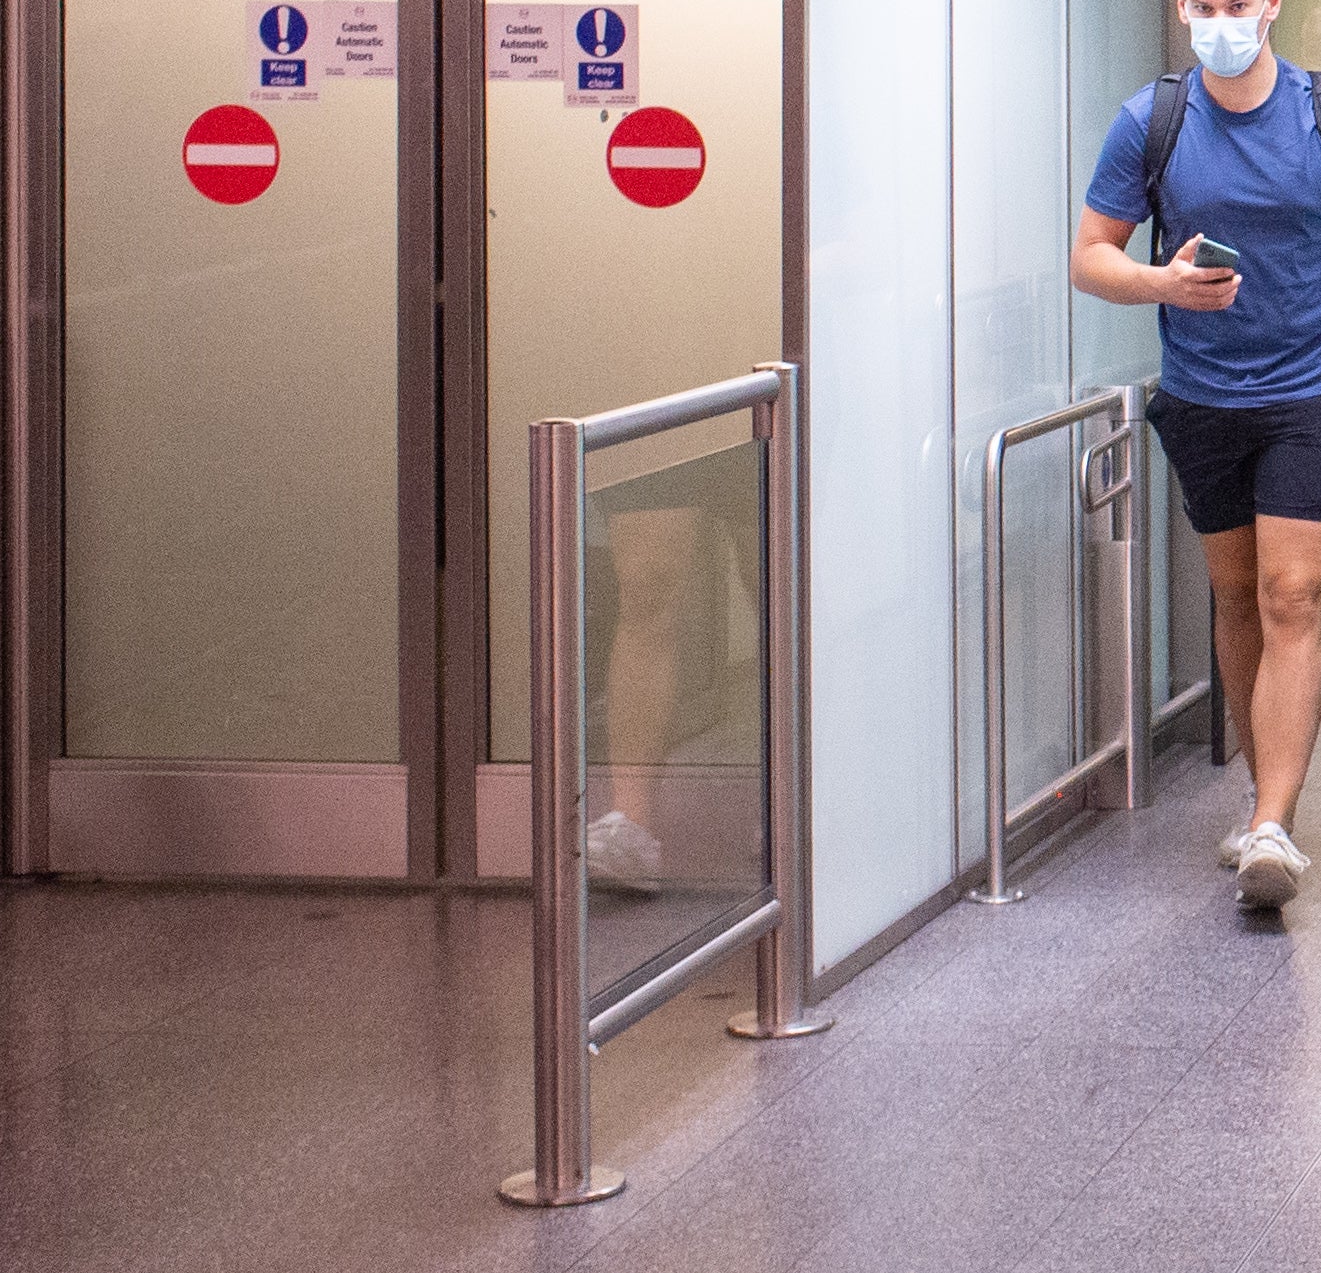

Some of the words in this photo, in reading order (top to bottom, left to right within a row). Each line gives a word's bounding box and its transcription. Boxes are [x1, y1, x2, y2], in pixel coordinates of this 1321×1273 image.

[341, 21, 378, 33] Caution
[505, 24, 543, 35] Caution
[335, 35, 384, 47] Automatic
[500, 38, 549, 50] Automatic
[345, 50, 374, 62] Doors
[510, 53, 538, 64] Doors
[268, 61, 298, 74] Keep
[586, 64, 616, 77] Keep
[269, 74, 298, 86] clear
[587, 78, 616, 89] clear
